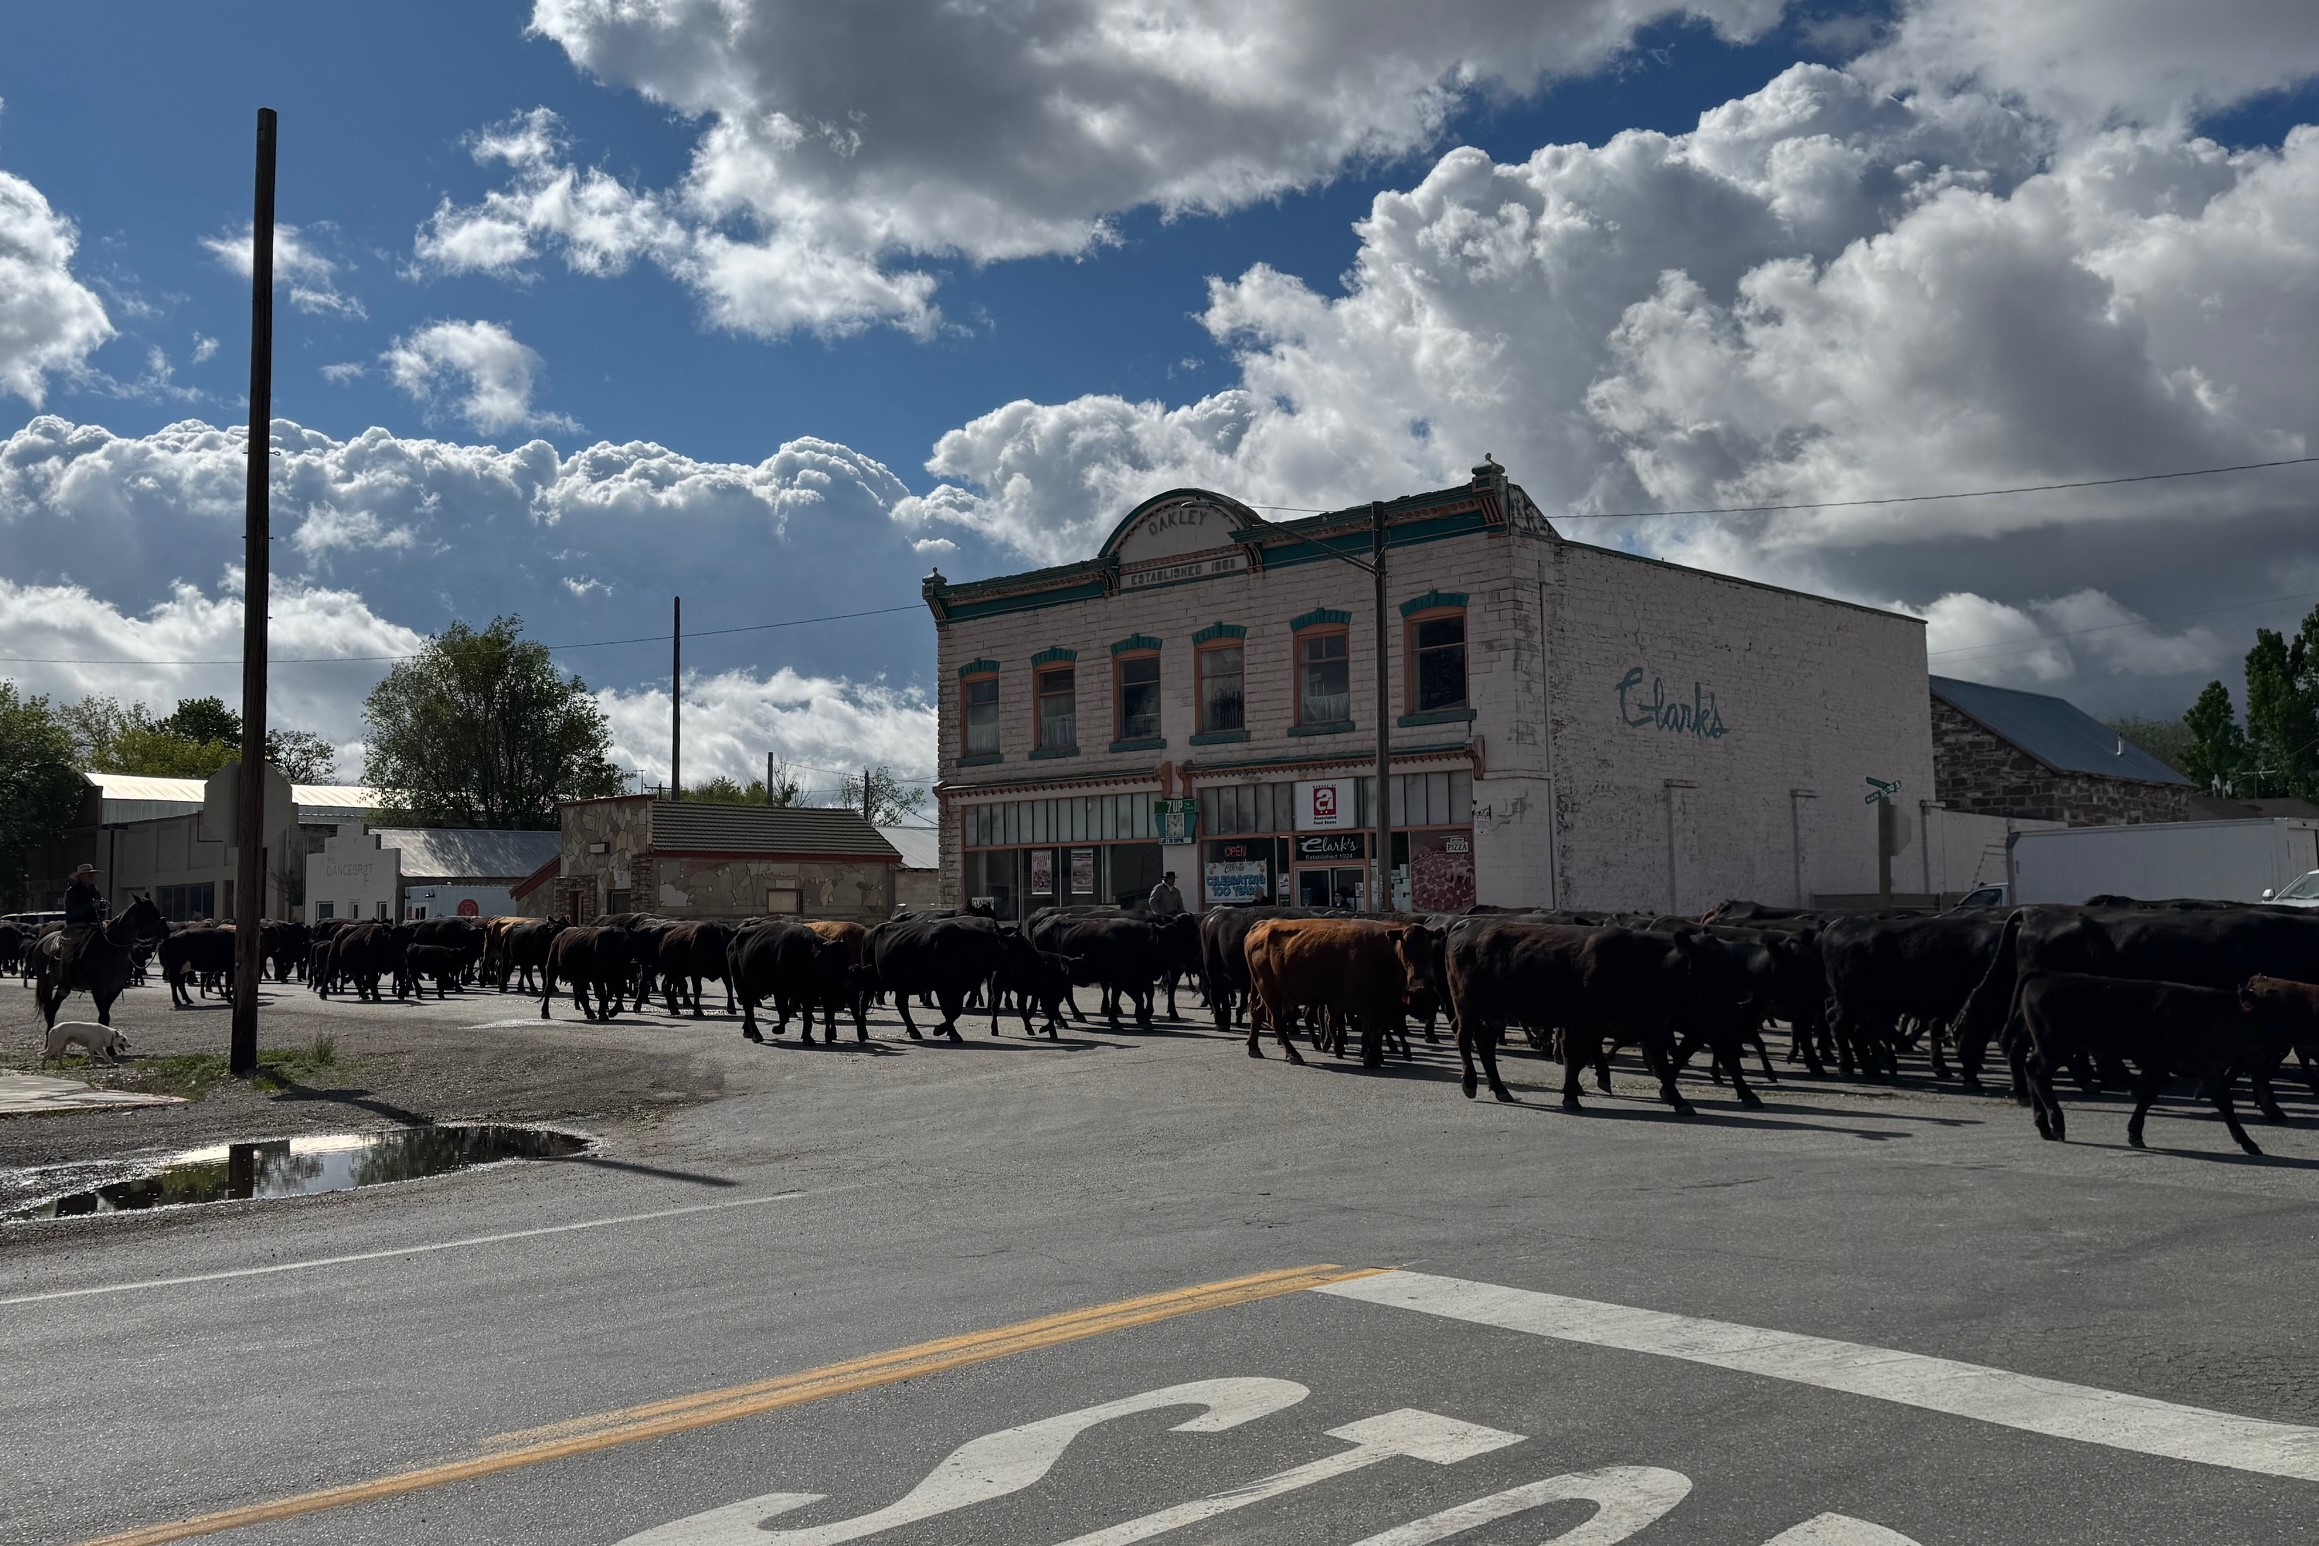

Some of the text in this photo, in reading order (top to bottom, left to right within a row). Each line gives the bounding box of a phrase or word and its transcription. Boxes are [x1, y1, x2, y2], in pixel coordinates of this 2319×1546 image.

[1148, 509, 1209, 536] OAKLEY
[1131, 564, 1202, 585] ESTABLISHED
[1616, 667, 1729, 739] Clark's
[1224, 845, 1247, 857] OPEN
[1300, 835, 1359, 852] Clark's
[1447, 843, 1467, 851] PIZZA
[1206, 874, 1266, 887] CELEBRATING
[1211, 885, 1256, 896] 100 YEAR
